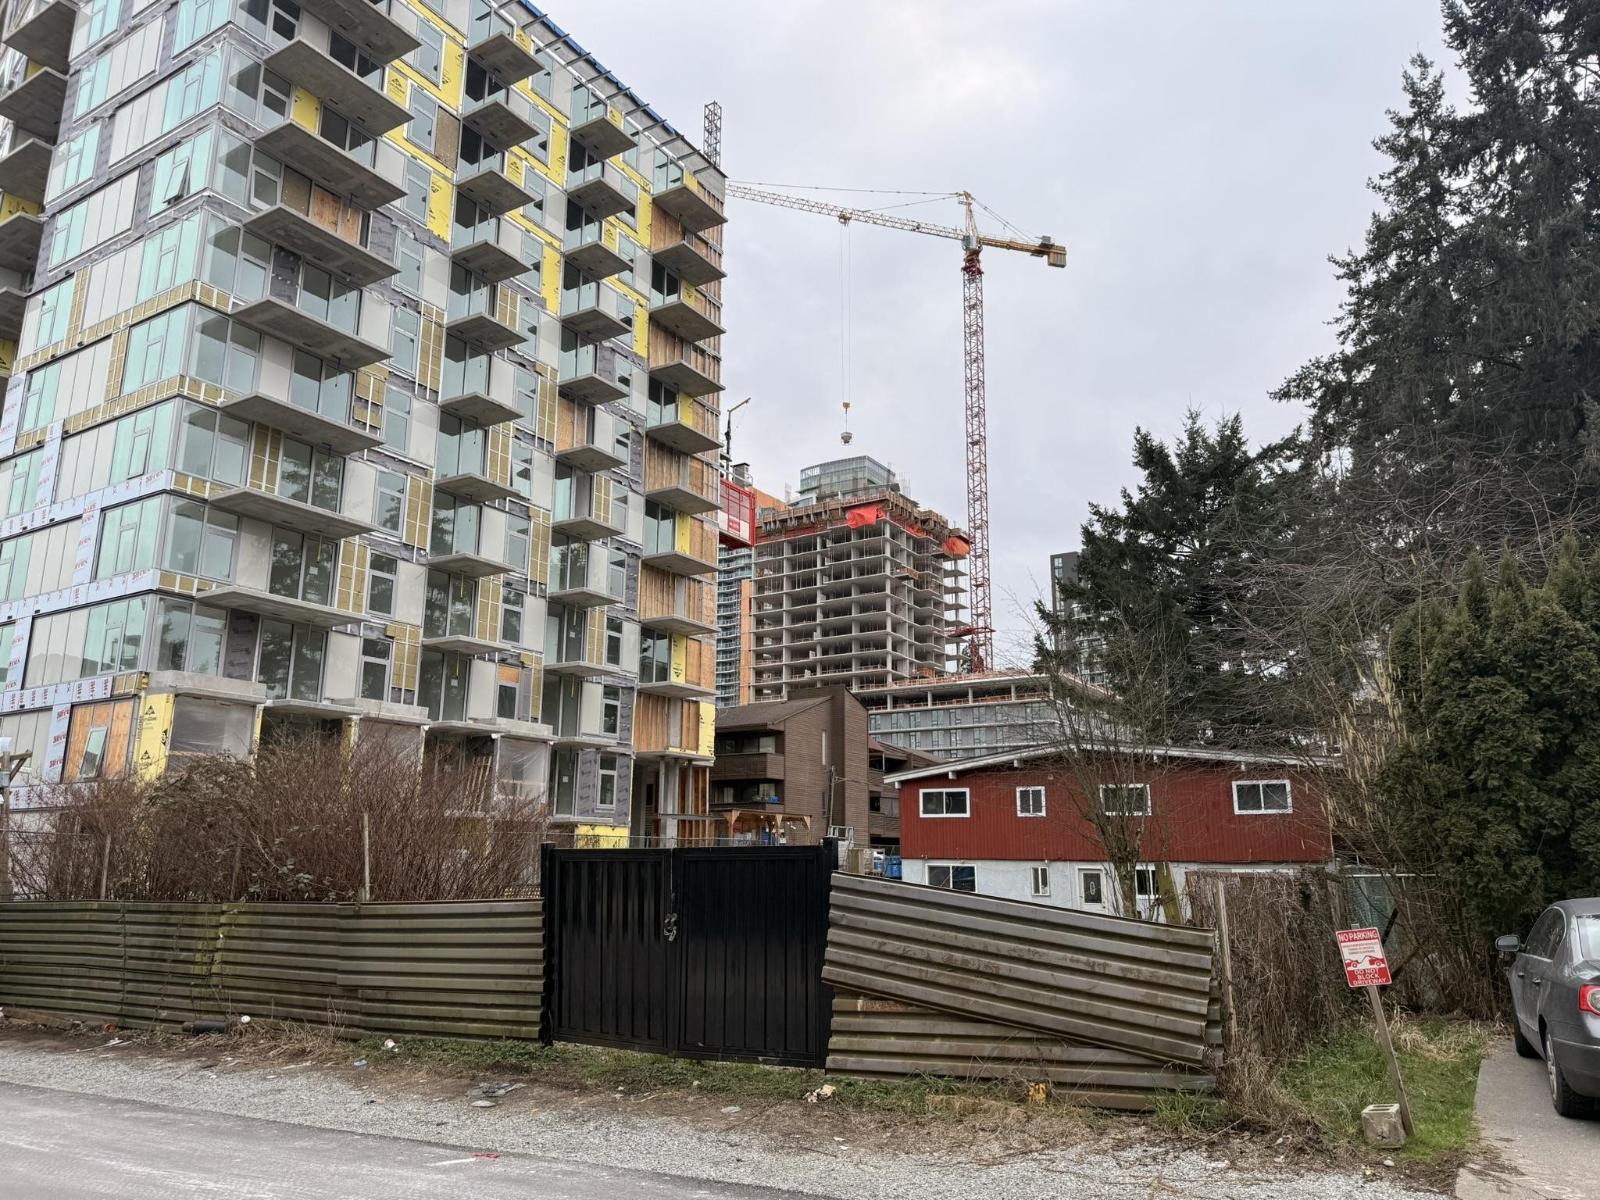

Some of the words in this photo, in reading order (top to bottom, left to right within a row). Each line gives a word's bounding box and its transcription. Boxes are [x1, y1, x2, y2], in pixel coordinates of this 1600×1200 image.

[1338, 934, 1349, 942] NO
[1349, 931, 1378, 941] PARKING
[1352, 977, 1387, 985] DRIVEWAY
